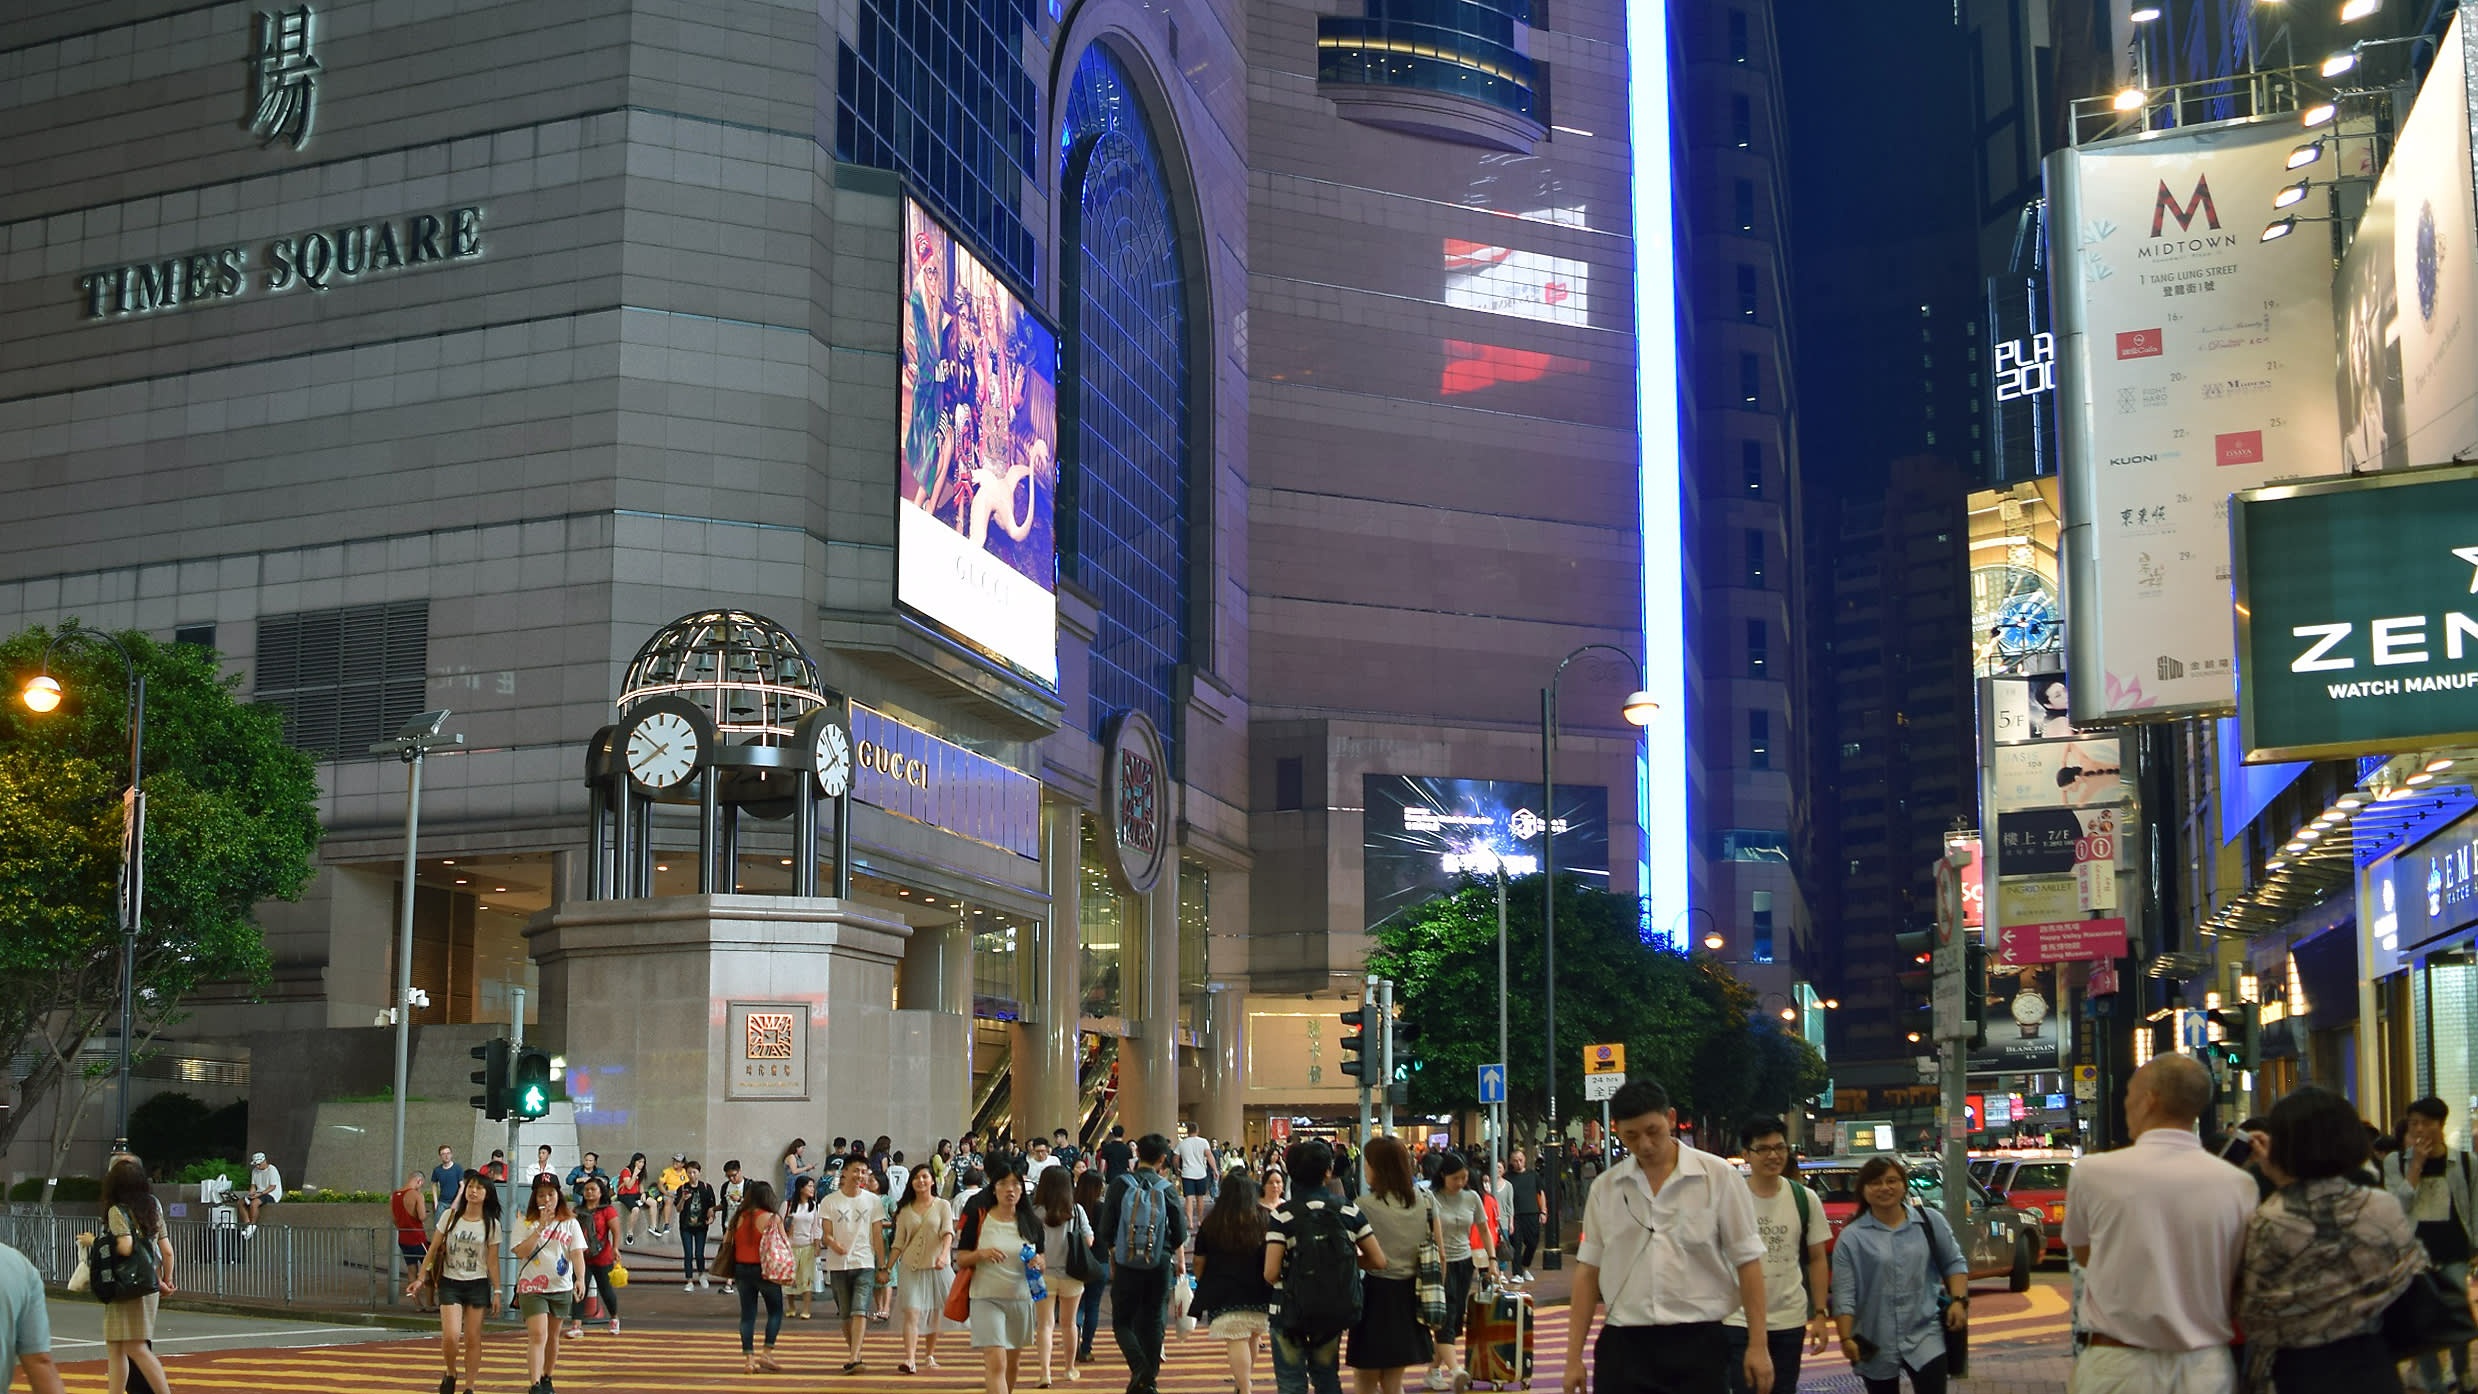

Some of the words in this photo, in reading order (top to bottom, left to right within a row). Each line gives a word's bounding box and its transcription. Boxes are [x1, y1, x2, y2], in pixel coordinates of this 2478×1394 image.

[249, 3, 321, 152] 場
[2138, 235, 2236, 259] MIDTOWN
[81, 245, 247, 319] TIMES
[264, 206, 485, 292] SQUARE
[2140, 275, 2145, 285] 1
[2151, 270, 2175, 283] TANG
[2177, 268, 2203, 281] LUNG
[2206, 264, 2238, 277] STREET
[2110, 454, 2158, 466] KUONI
[2327, 680, 2399, 700] WATCH
[2405, 672, 2478, 693] MANUF
[1998, 710, 2024, 729] 5/F
[858, 739, 928, 790] GUCCI
[2047, 830, 2070, 840] 7/F
[2005, 1044, 2055, 1053] BLANCPAIN
[894, 1175, 900, 1186] 7
